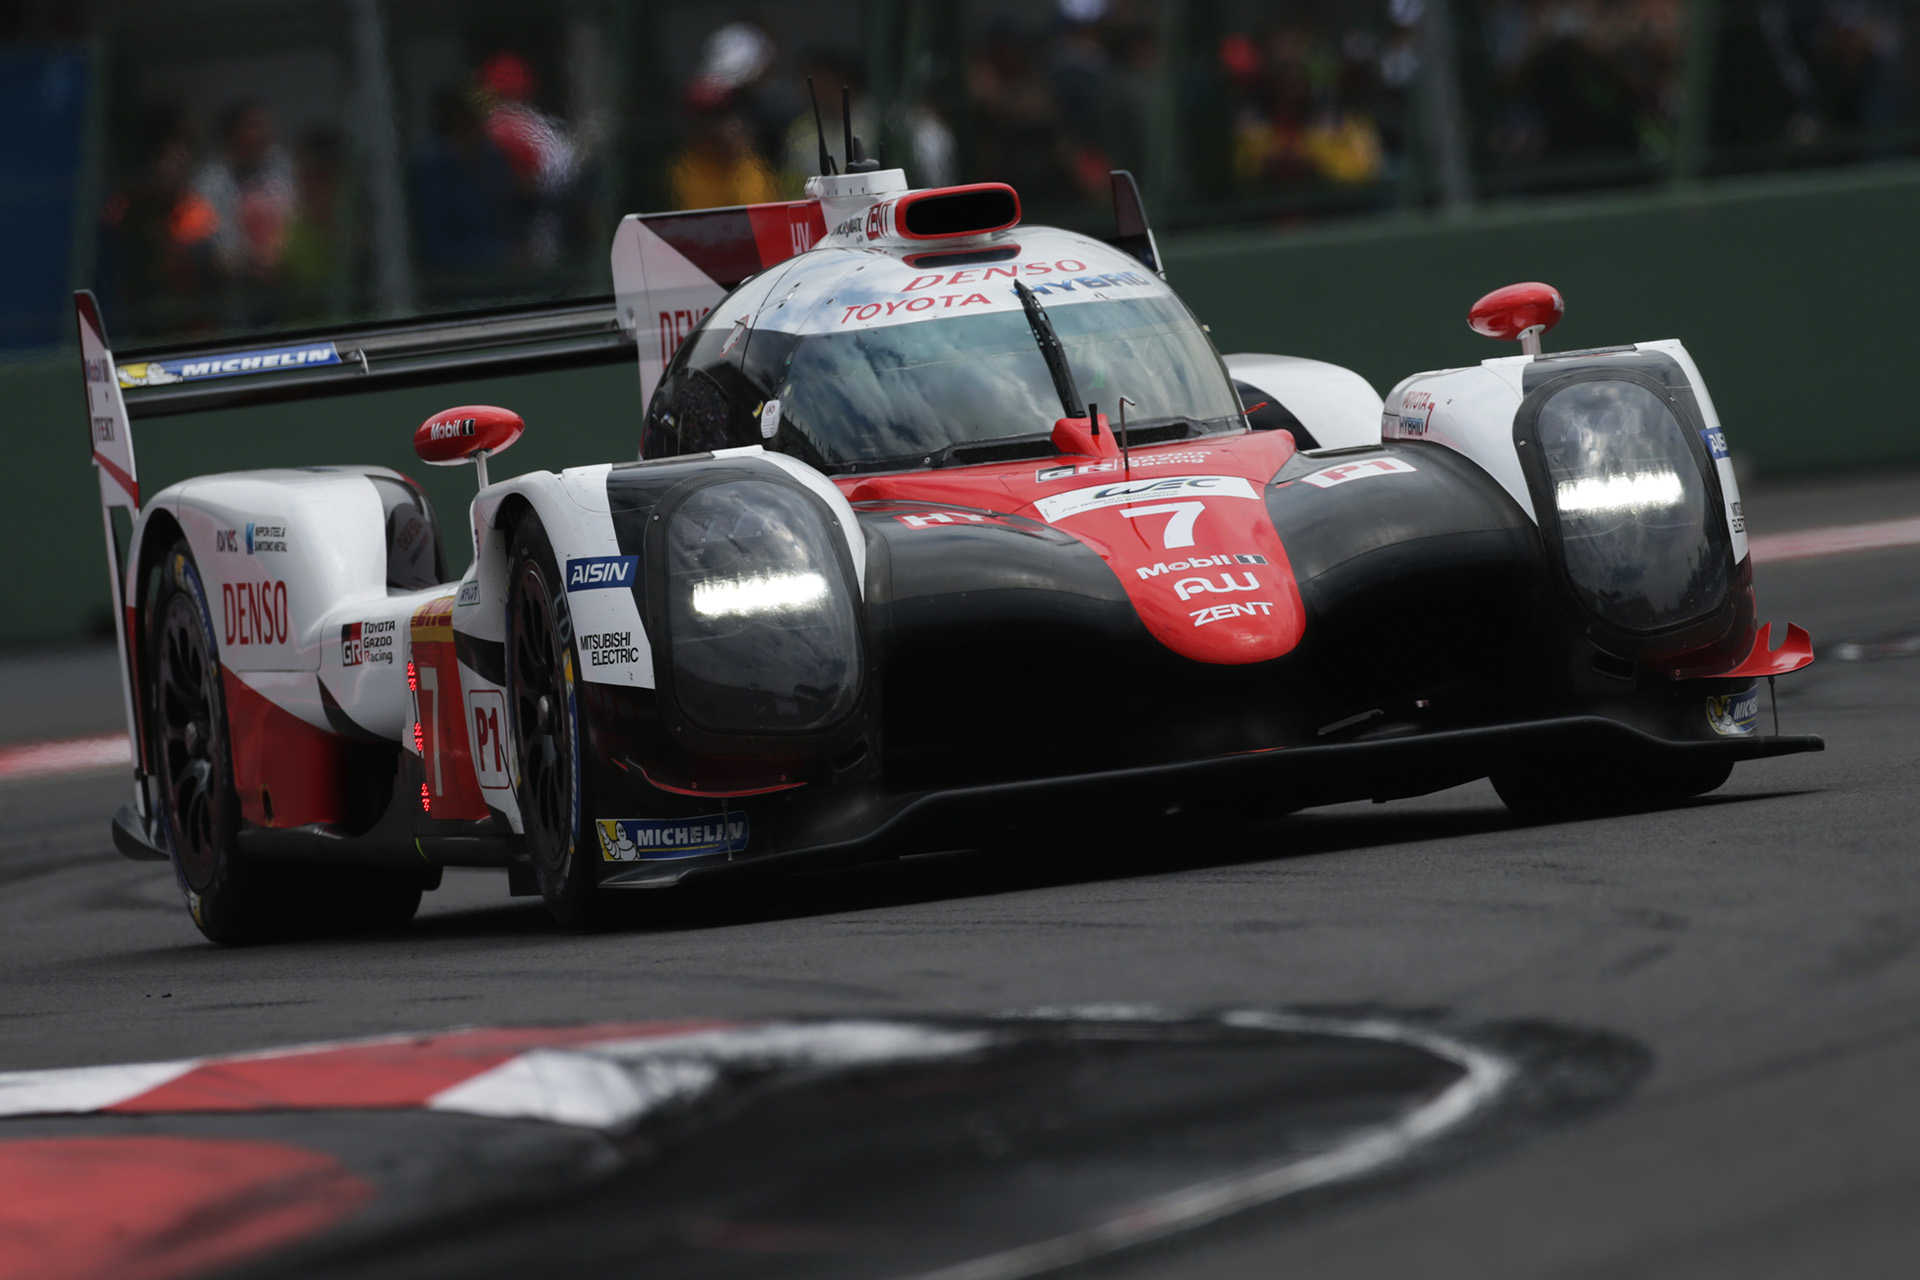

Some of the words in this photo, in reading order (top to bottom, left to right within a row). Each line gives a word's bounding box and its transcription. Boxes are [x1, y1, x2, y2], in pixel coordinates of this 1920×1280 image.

[900, 259, 1087, 293] DENSO
[1010, 271, 1152, 297] HYBRID
[840, 293, 993, 325] TOYOTA
[181, 348, 332, 377] MICHELIN
[1402, 391, 1431, 411] TOYOTA
[430, 420, 461, 441] Mobil
[1320, 461, 1398, 481] P1
[1119, 501, 1206, 549] 7
[570, 562, 629, 585] AISIN
[1136, 554, 1232, 580] Mobil
[222, 580, 288, 646] DENSO
[1189, 601, 1273, 627] ZENT
[364, 620, 395, 634] TOYOTA
[343, 639, 363, 667] GR
[580, 631, 631, 651] MITSUBISHI
[363, 650, 393, 664] Racing
[591, 647, 639, 666] ELECTRIC
[419, 666, 444, 797] 7
[473, 706, 502, 773] P1
[636, 821, 744, 847] MICHELIN
